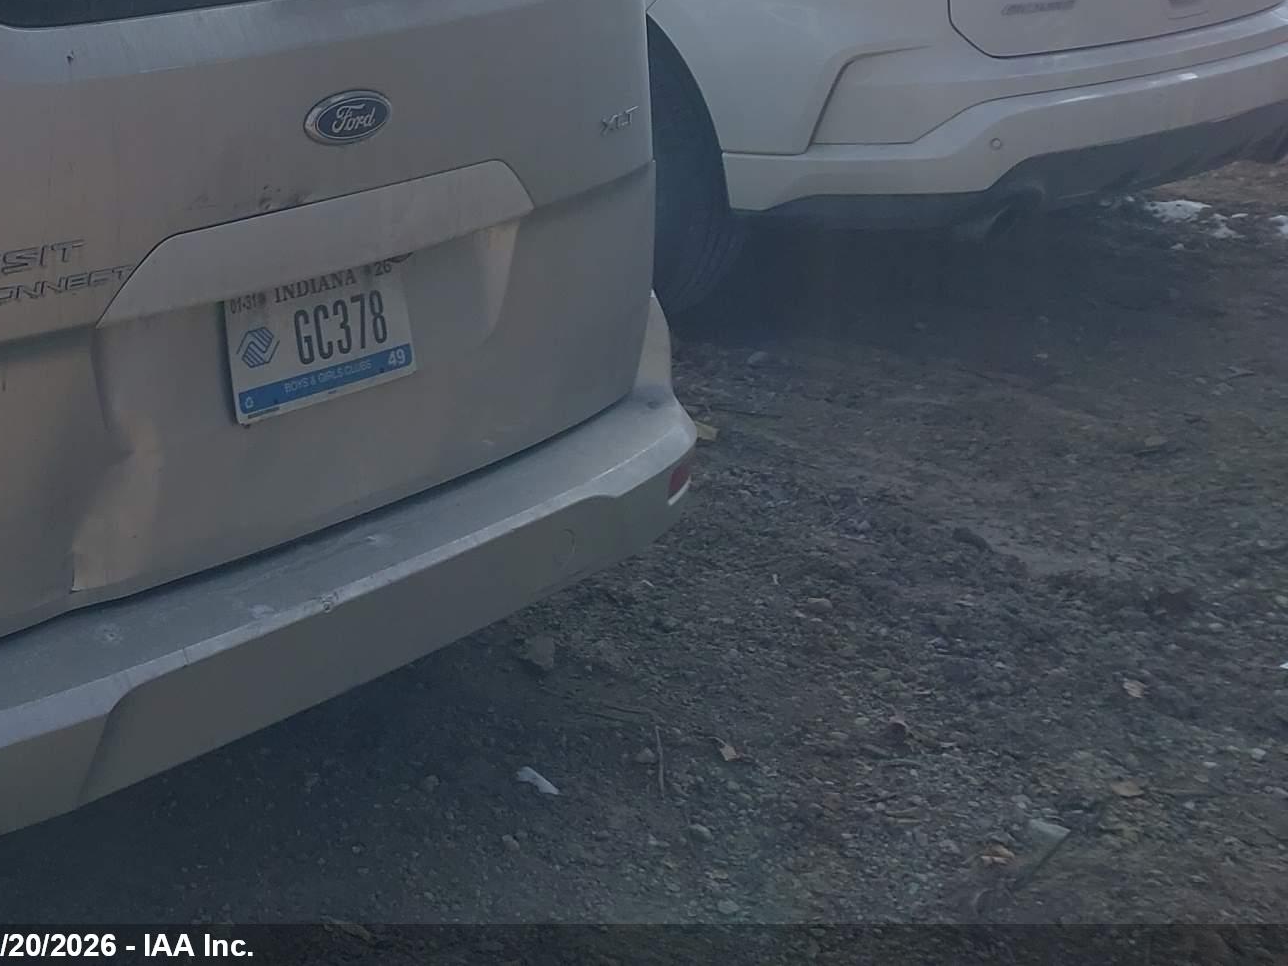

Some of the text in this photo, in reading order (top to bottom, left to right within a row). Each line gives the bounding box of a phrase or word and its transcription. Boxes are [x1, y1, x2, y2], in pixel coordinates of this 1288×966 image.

[331, 104, 375, 133] Ford
[600, 105, 640, 137] XLT
[274, 269, 357, 303] INDIANA
[293, 289, 388, 365] GC378
[387, 348, 407, 368] 49
